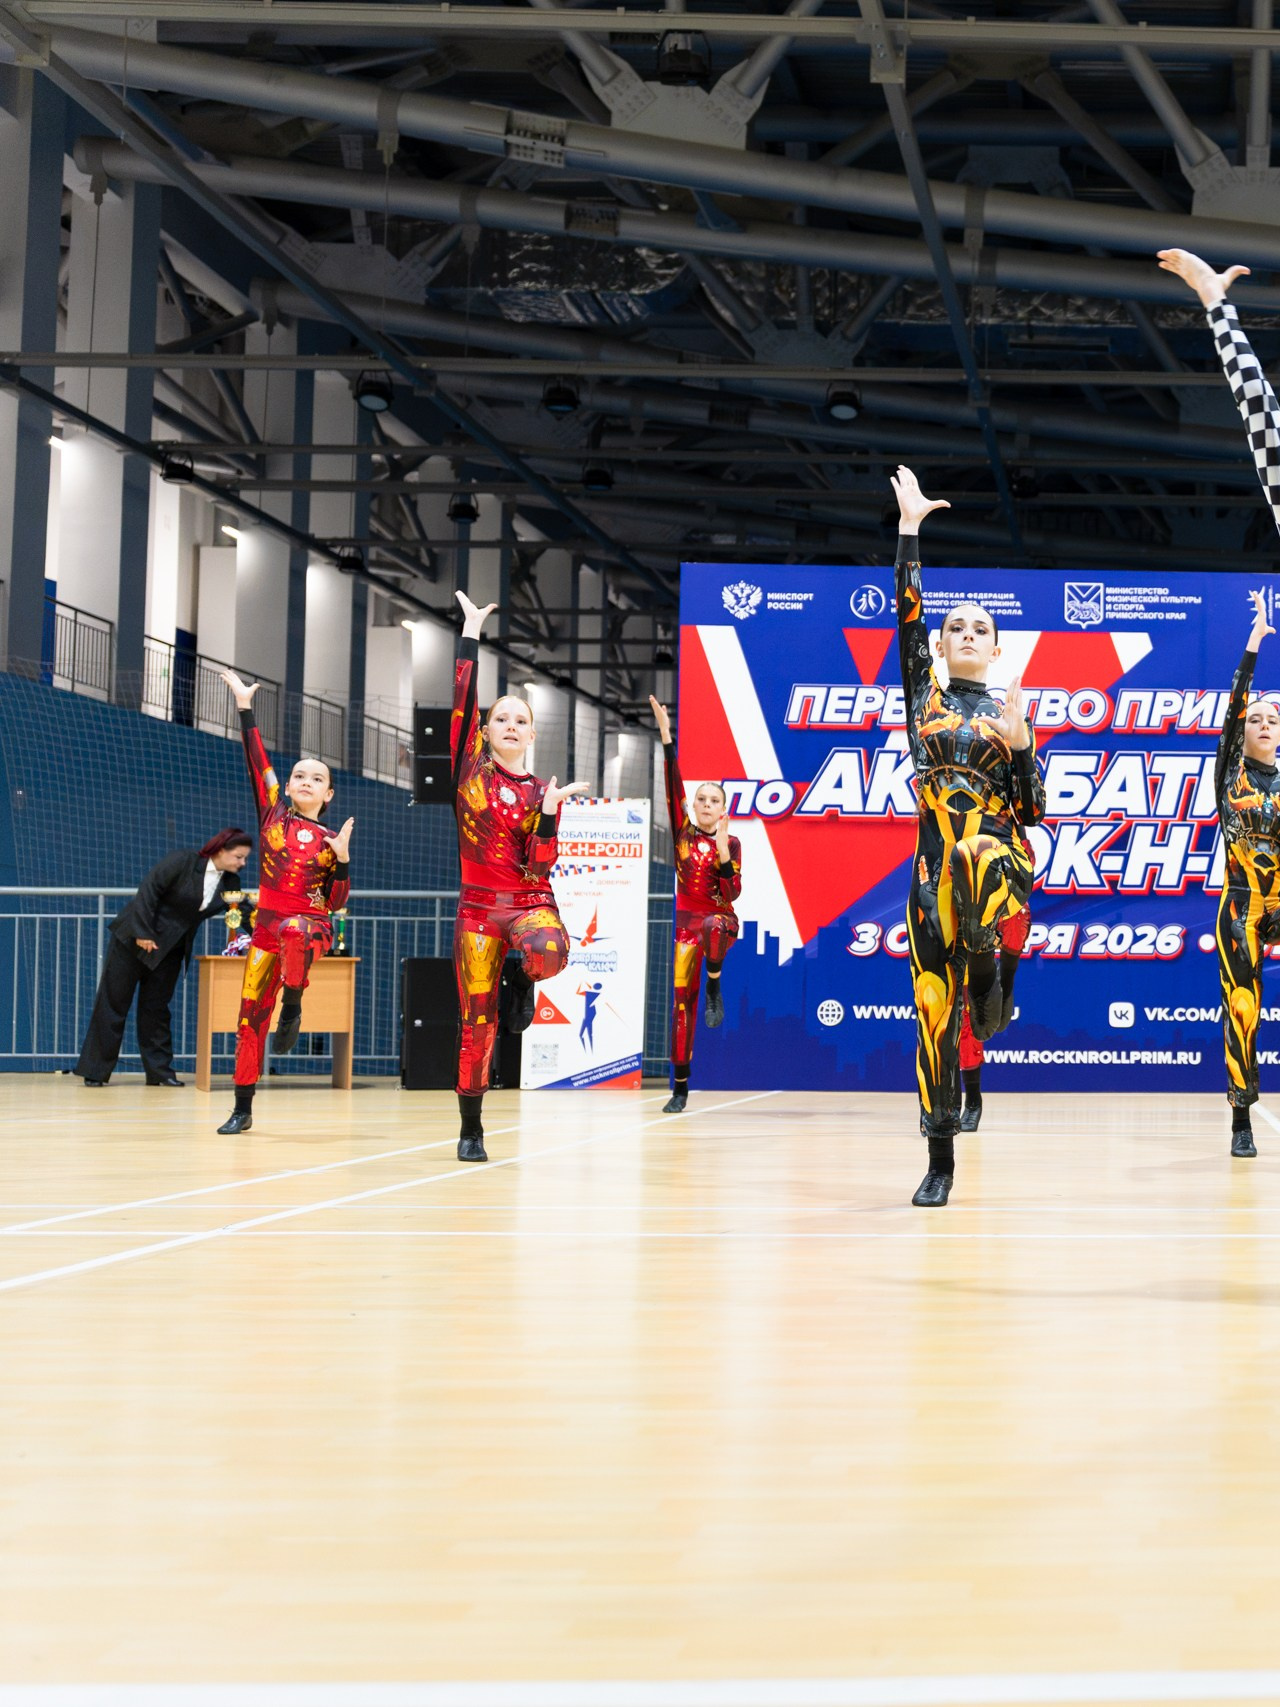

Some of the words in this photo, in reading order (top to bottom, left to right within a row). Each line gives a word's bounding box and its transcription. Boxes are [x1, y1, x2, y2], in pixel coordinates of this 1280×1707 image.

[1105, 587, 1169, 595] МИНИСТЕРСТВО
[766, 592, 814, 601] МИНСПОРТ
[966, 592, 1015, 600] ФЕДЕРАЦИЯ
[1105, 595, 1159, 603] ФИЗИЧЕСКОЙ
[1160, 596, 1202, 604] КУЛЬТУРЫ
[767, 602, 803, 610] РОССИИ
[1113, 603, 1145, 611] СПОРТА
[1105, 612, 1164, 620] ПРИМОРСКОГО
[1165, 612, 1187, 620] КРАЯ
[558, 830, 641, 840] ОБАТИЧЕСКИЙ
[558, 842, 641, 857] К-Н-РОЛЛ
[1079, 923, 1185, 956] 2026
[983, 1050, 1201, 1065] WWW.ROCKNROLLPRIM.RU
